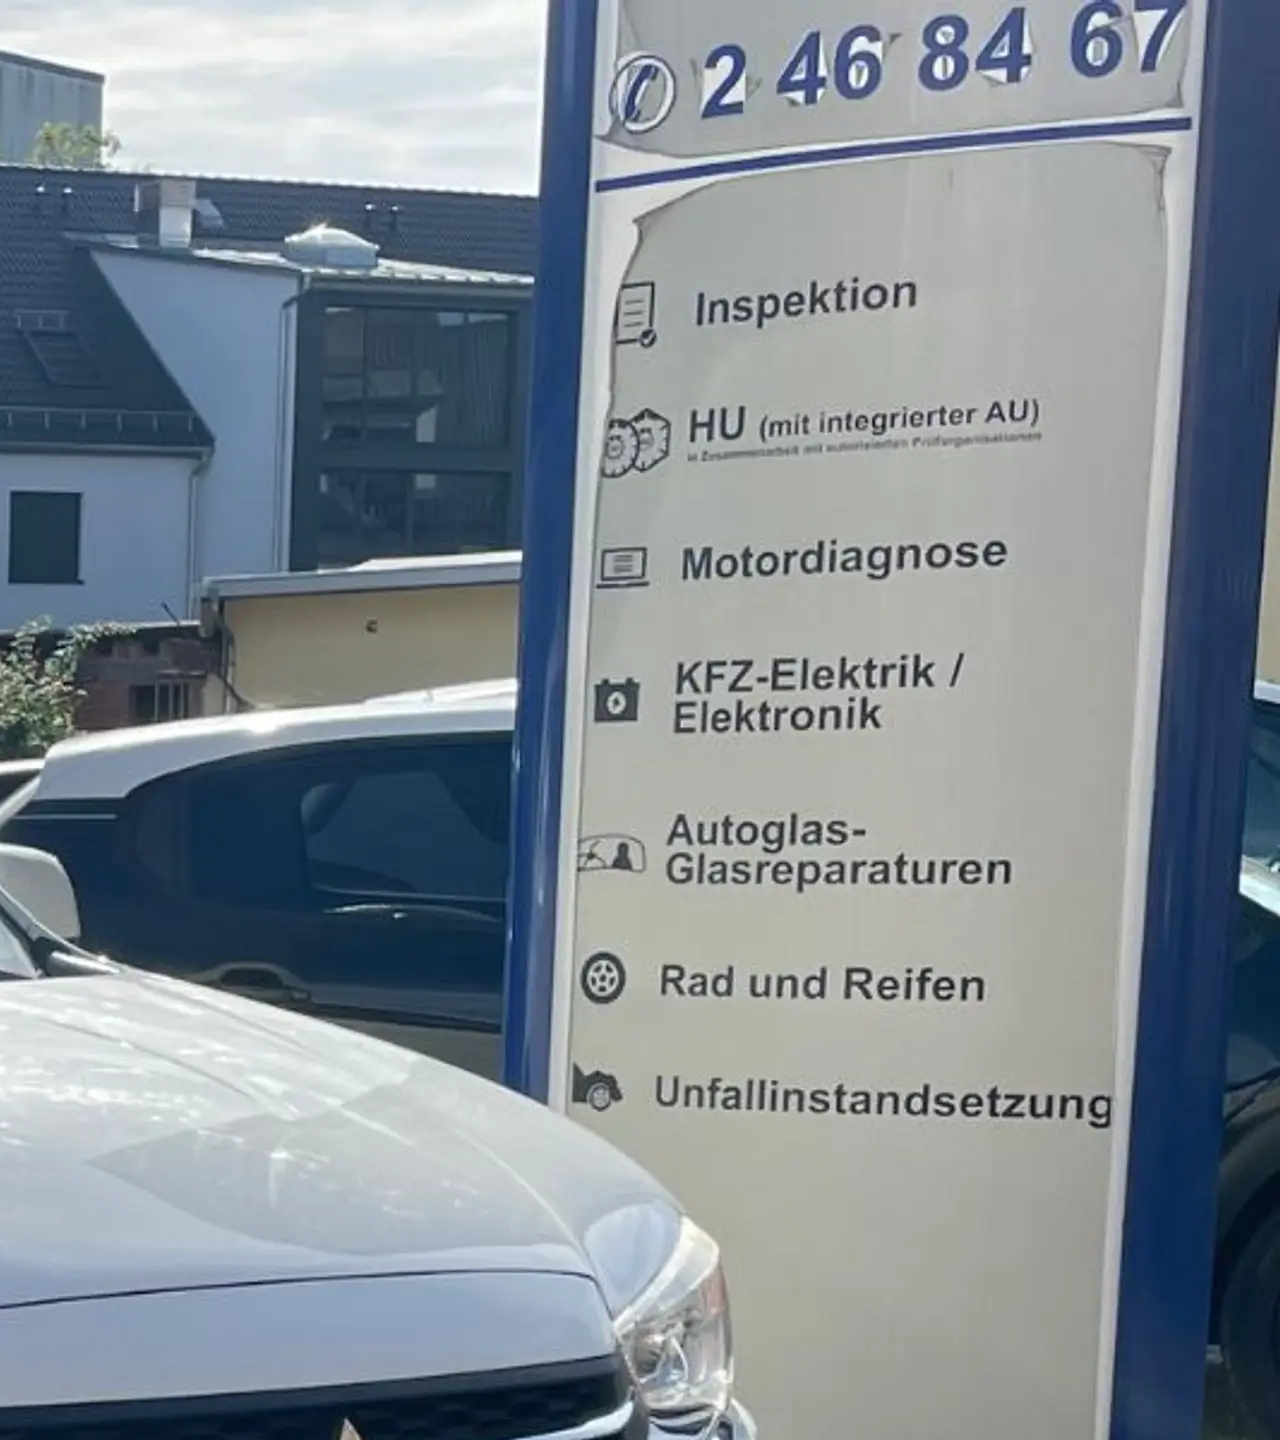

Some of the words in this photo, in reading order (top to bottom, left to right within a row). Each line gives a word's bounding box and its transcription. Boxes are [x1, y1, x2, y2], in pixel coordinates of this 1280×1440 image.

[701, 45, 748, 119] 2
[777, 24, 884, 105] 46
[919, 7, 1033, 91] 84
[1070, 0, 1186, 78] 67
[696, 277, 917, 329] Inspektion
[689, 405, 746, 443] HU
[760, 413, 810, 443] (mit
[819, 405, 978, 436] integrierter
[985, 399, 1039, 427] AU)
[682, 539, 1008, 580] Motordiagnose
[675, 654, 935, 694] KFZ-Elektrik
[949, 652, 965, 687] /
[674, 697, 882, 733] Elektronik
[666, 813, 867, 853] Autoglas-
[666, 852, 1013, 893] Glasreparaturen
[660, 964, 735, 998] Rad
[749, 967, 828, 999] und
[843, 967, 986, 1001] Reifen
[655, 1075, 1113, 1128] Unfallinstandsetzung
